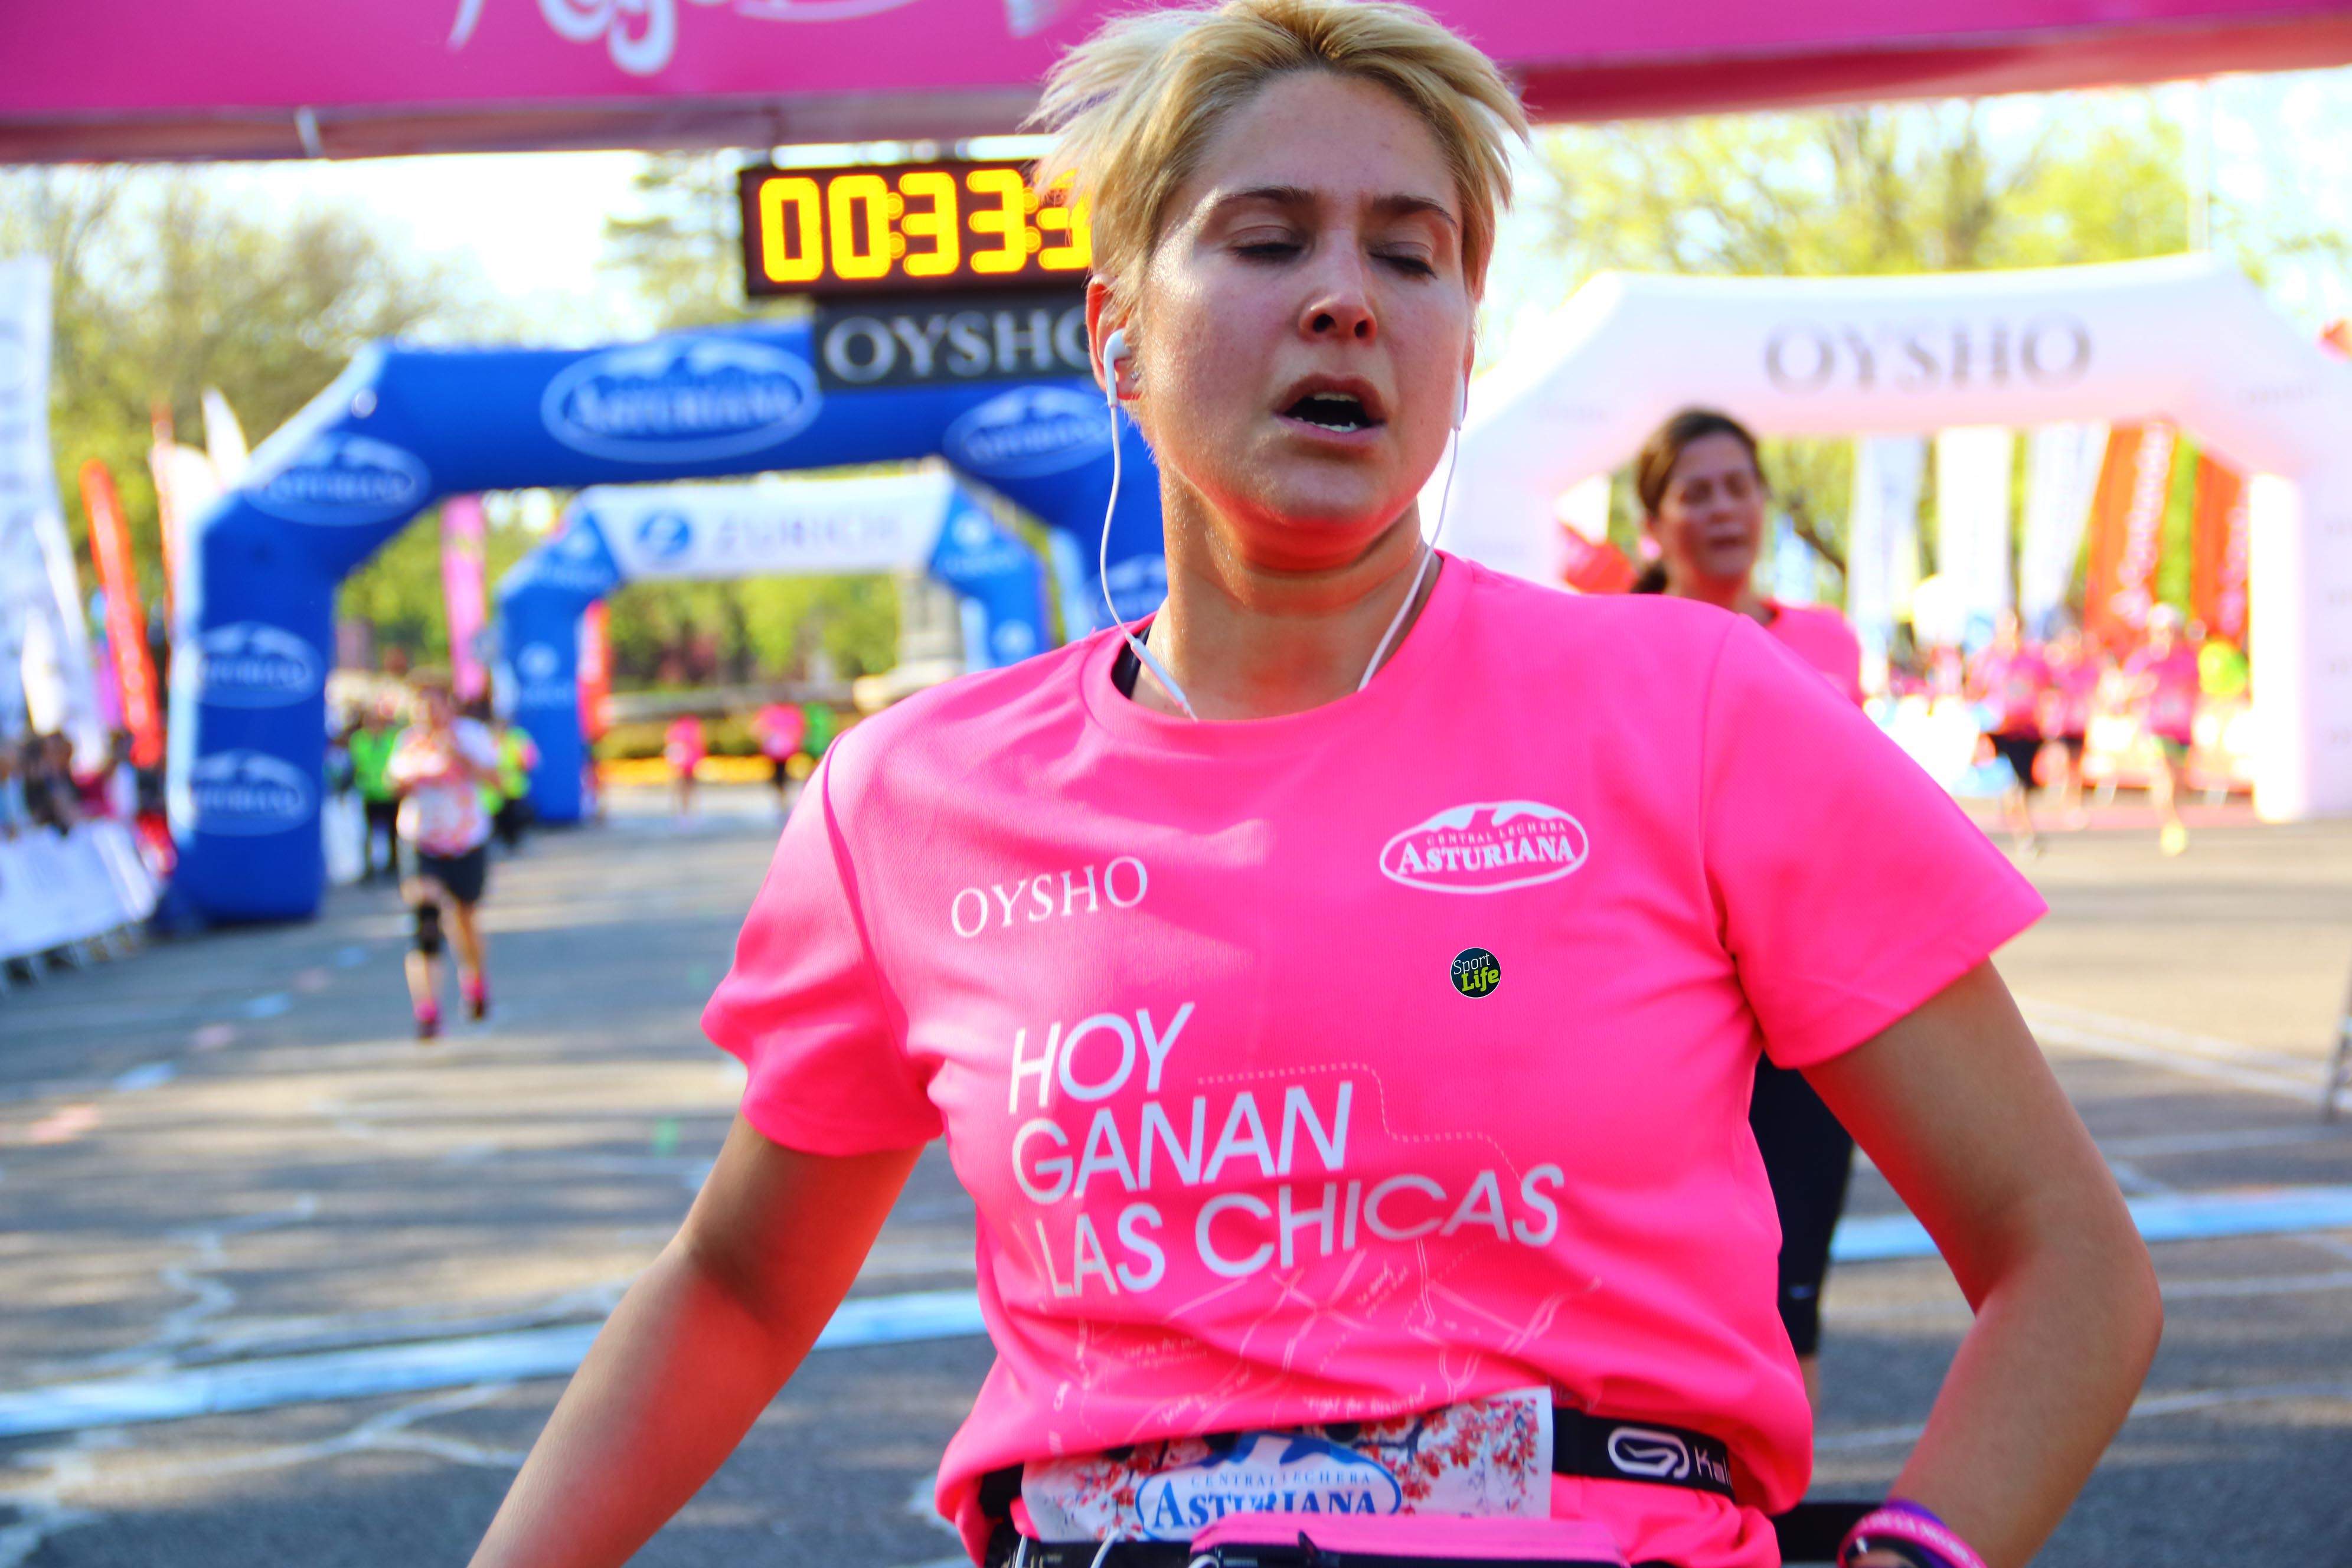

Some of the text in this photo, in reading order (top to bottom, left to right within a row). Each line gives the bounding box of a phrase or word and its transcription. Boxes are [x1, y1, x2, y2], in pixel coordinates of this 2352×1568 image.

[1764, 312, 2093, 396] OYSHO
[1397, 834, 1576, 875] ASTURIANA
[1500, 821, 1567, 838] LECHERA
[951, 856, 1148, 937] OYSHO
[1453, 953, 1491, 975] Sport
[1461, 966, 1500, 992] Life
[1008, 1002, 1195, 1115] HOY
[1011, 1081, 1353, 1203] GANAN
[1035, 1164, 1565, 1298] LAS CHICAS
[1693, 1445, 1733, 1490] Kal
